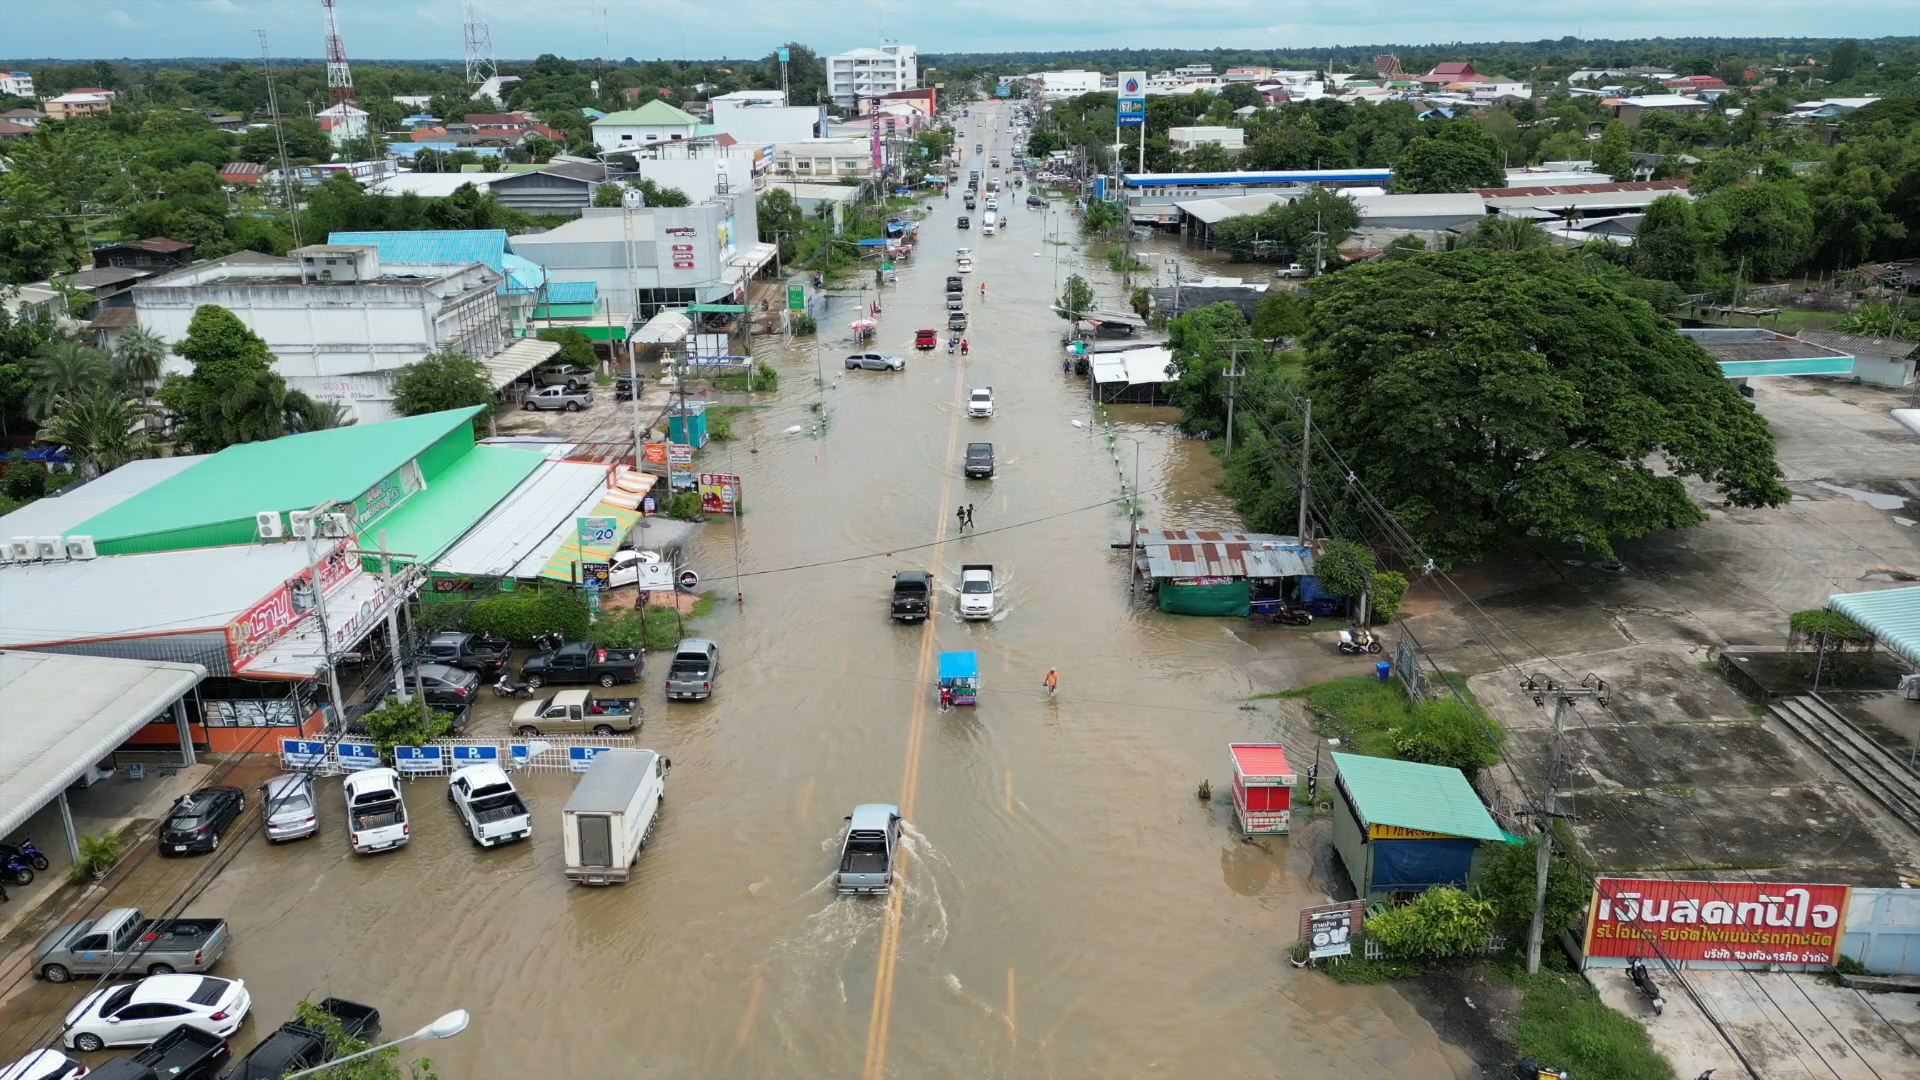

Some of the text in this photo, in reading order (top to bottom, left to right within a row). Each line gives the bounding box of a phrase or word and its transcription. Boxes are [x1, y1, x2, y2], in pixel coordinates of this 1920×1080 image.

[1598, 888, 1838, 928] เงินสดทันใจ
[1704, 948, 1730, 959] บริษัท
